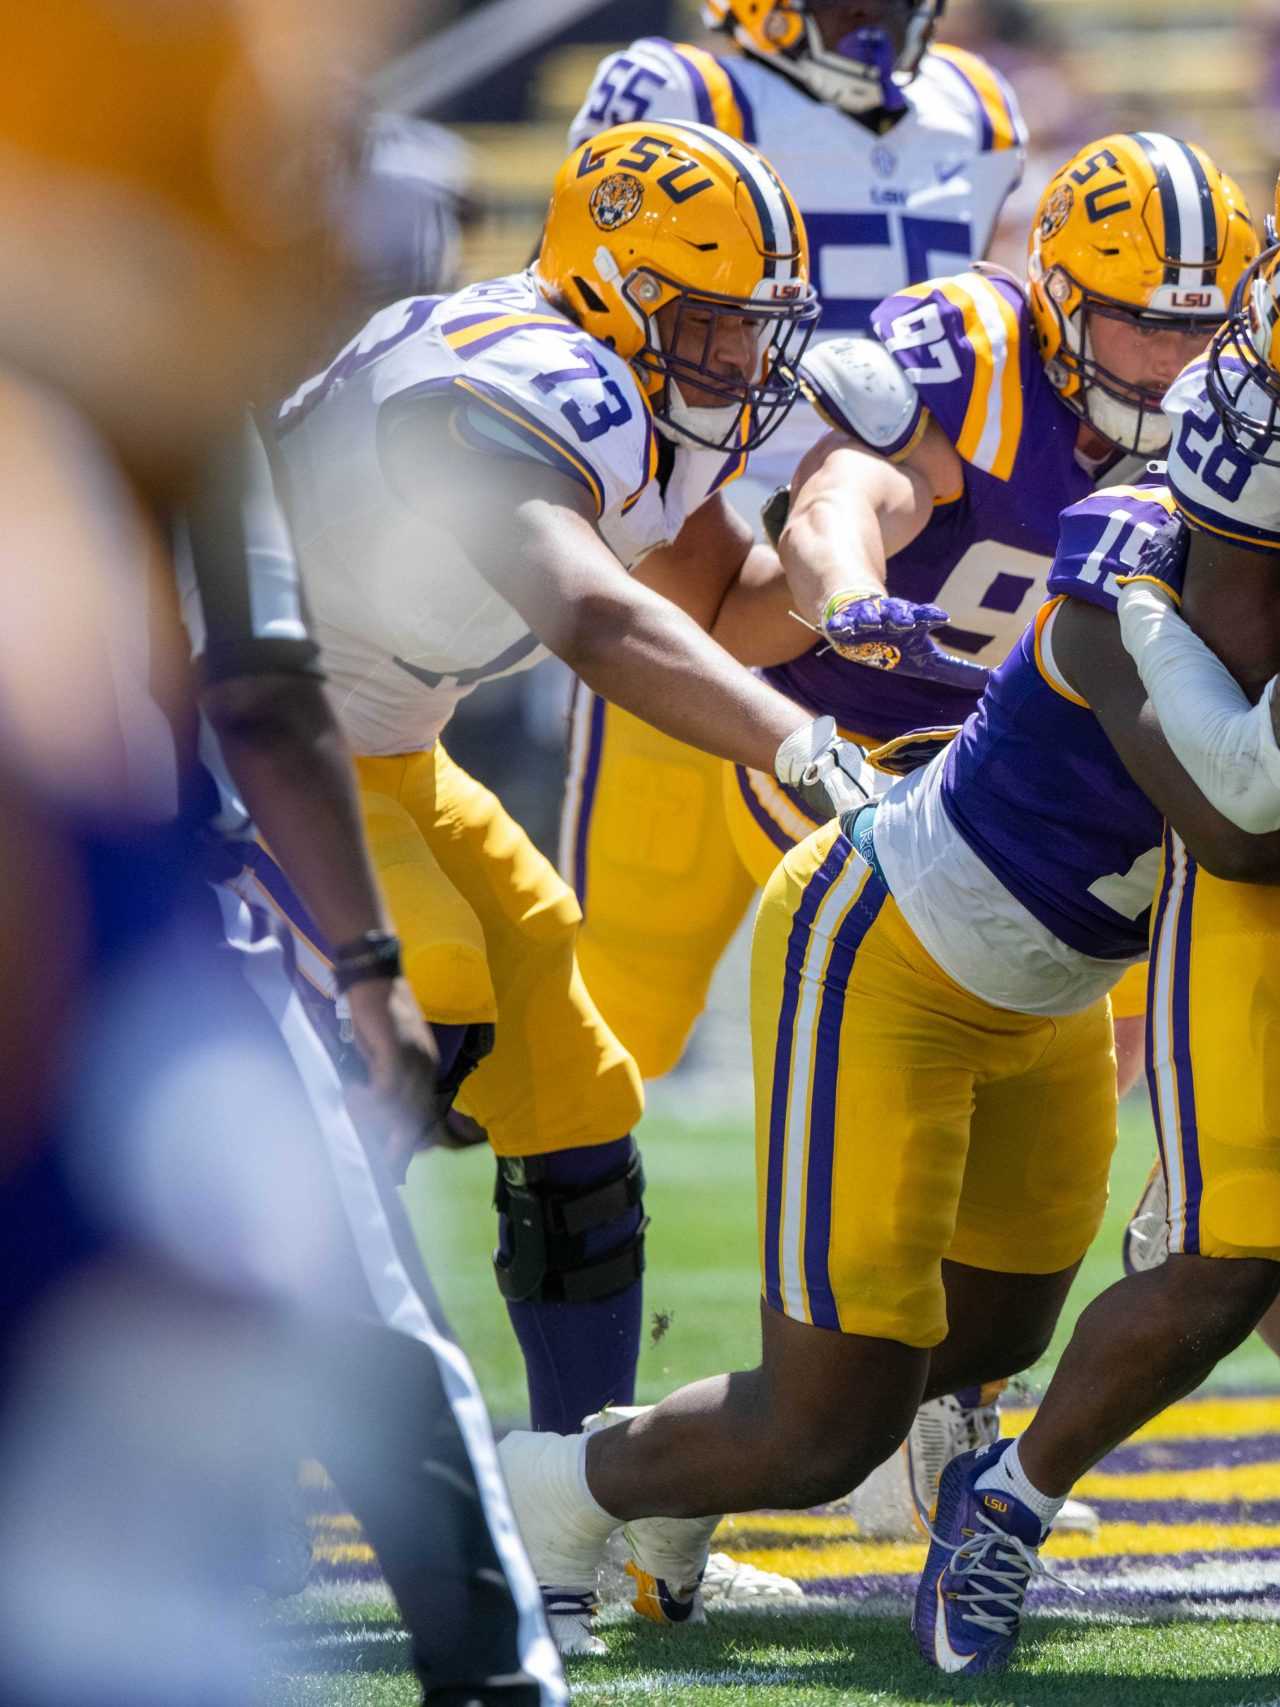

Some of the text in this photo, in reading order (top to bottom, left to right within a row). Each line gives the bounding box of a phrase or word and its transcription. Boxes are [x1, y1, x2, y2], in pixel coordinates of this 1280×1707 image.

[588, 58, 667, 122] 55
[575, 136, 714, 204] LSU
[771, 284, 800, 299] LSU
[1171, 293, 1212, 308] LSU
[889, 302, 962, 384] 97
[531, 343, 632, 443] 73
[1176, 387, 1273, 503] 28
[984, 1495, 1008, 1513] LSU
